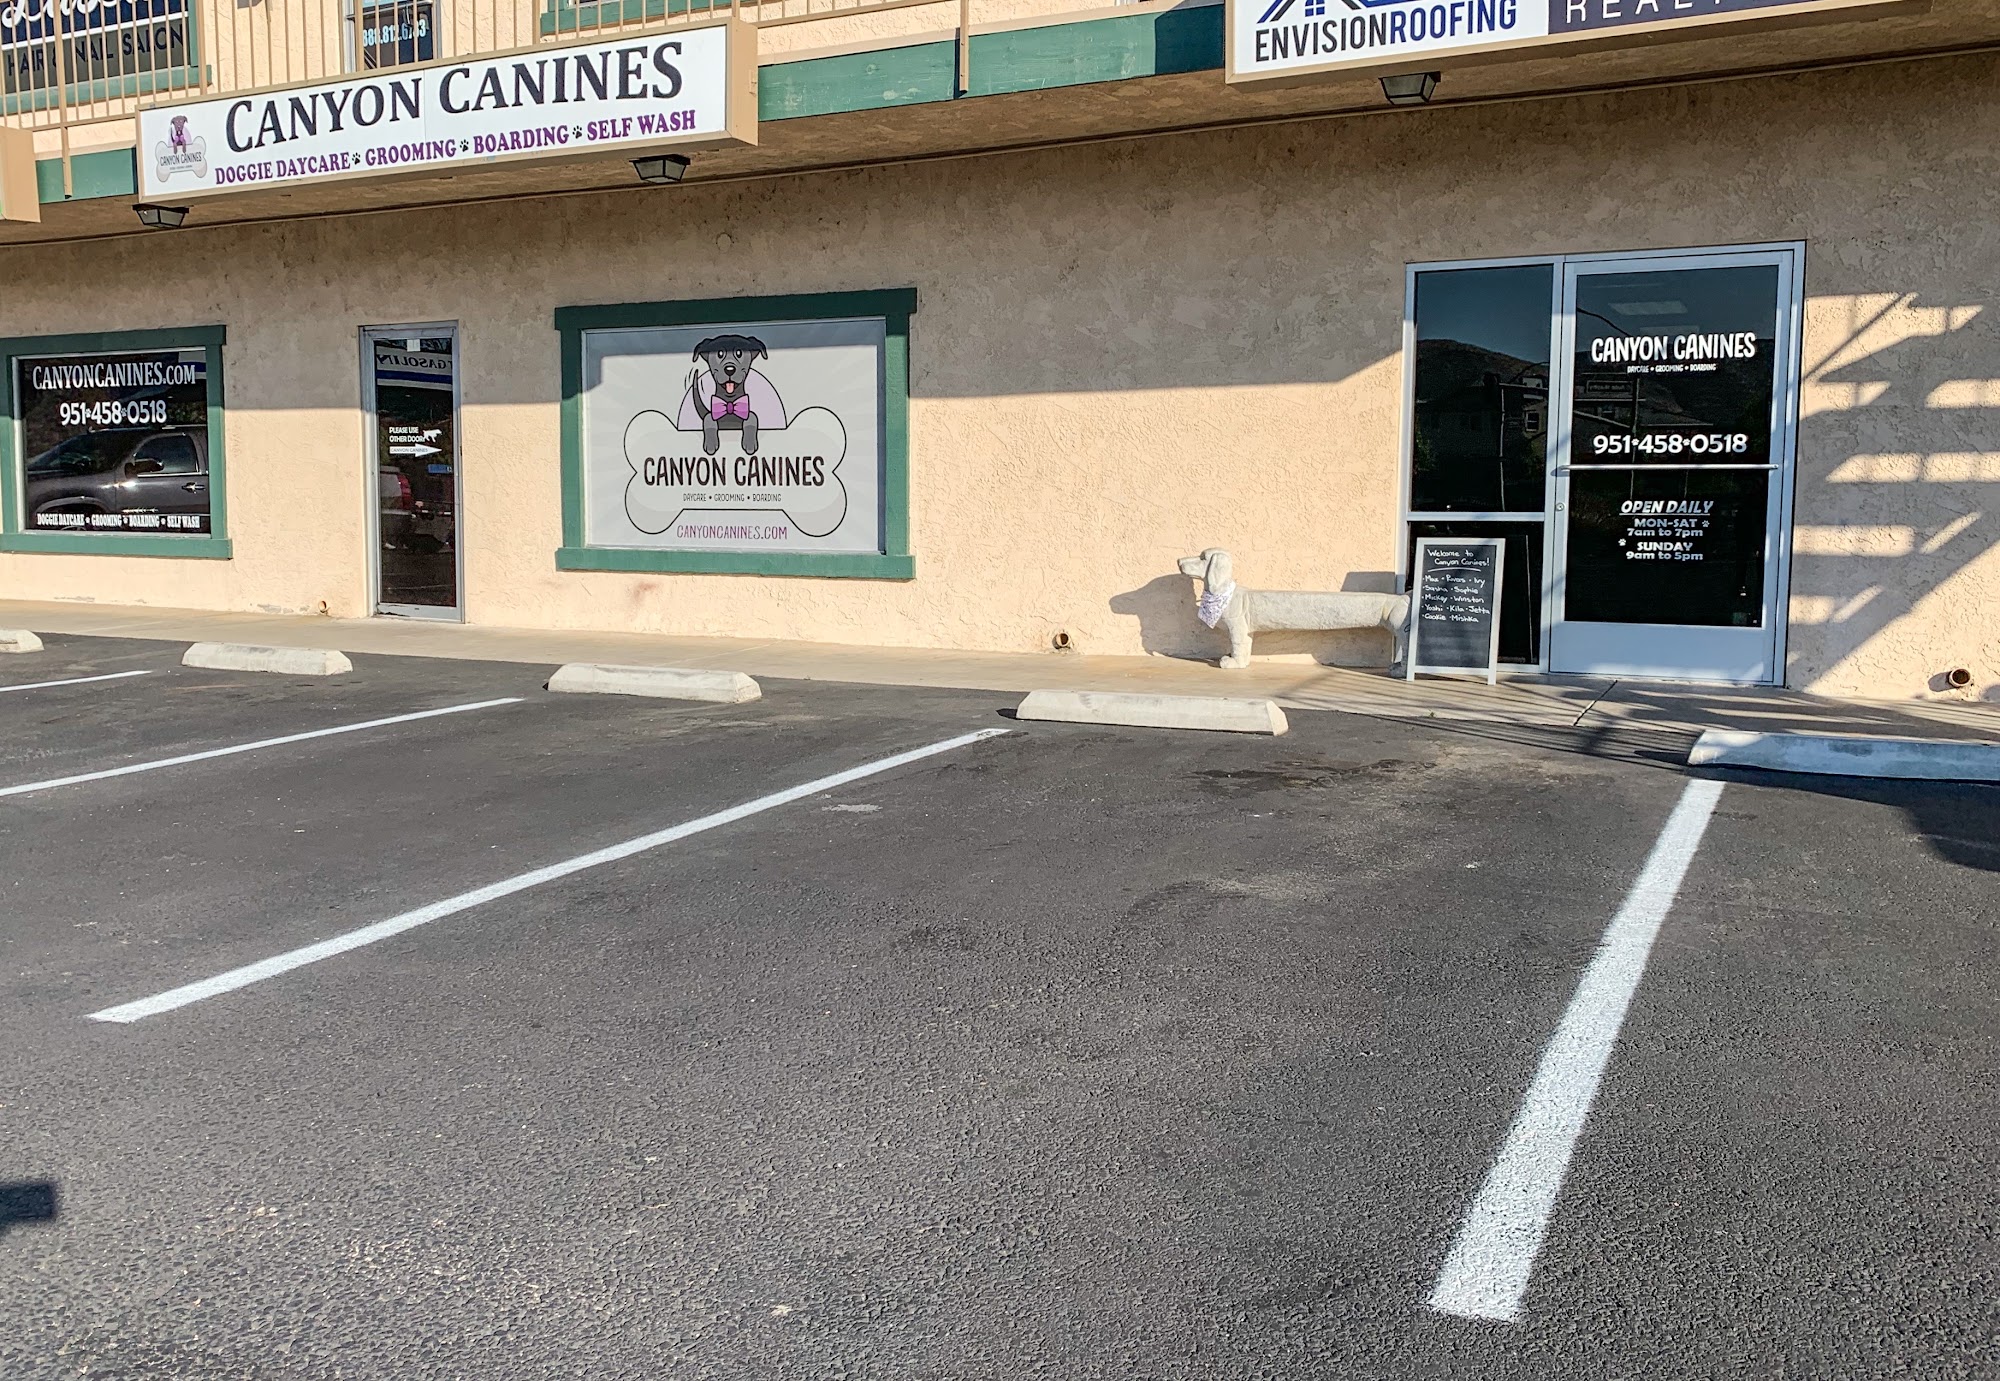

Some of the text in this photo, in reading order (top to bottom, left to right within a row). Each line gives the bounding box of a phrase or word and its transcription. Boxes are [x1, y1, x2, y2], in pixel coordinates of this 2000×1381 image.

[225, 41, 682, 153] CANYON CANINES
[215, 109, 696, 185] DOGGIE DAYCARE GROOMING BOARDING SELF WASH
[1591, 332, 1756, 363] CANYON CANINES
[1627, 363, 1717, 374] DAYCARE GROOMING BOARDING
[32, 361, 196, 390] CANYONCANINES.COM
[389, 426, 419, 434] PLEASE USE
[389, 435, 407, 443] OTHER
[643, 455, 825, 487] CANYON CANINES
[683, 493, 782, 502] DAYCARE GROOMING BOARDING
[1621, 500, 1714, 514] OPEN DAILY
[37, 513, 200, 529] DOGGIE DAYCARE GROOMING BOARDING SELF WASH
[1634, 518, 1698, 528] MON-SAT
[676, 524, 788, 540] CANYONCANINES.COM
[1627, 528, 1704, 538] 7am to 7pm
[1637, 541, 1693, 552] SUNDAY
[1427, 548, 1474, 557] Welcome to
[1625, 551, 1704, 561] 9am to 5pm
[1434, 557, 1459, 567] Canyon
[1474, 577, 1486, 588] Ivy
[1453, 595, 1485, 604] Winston
